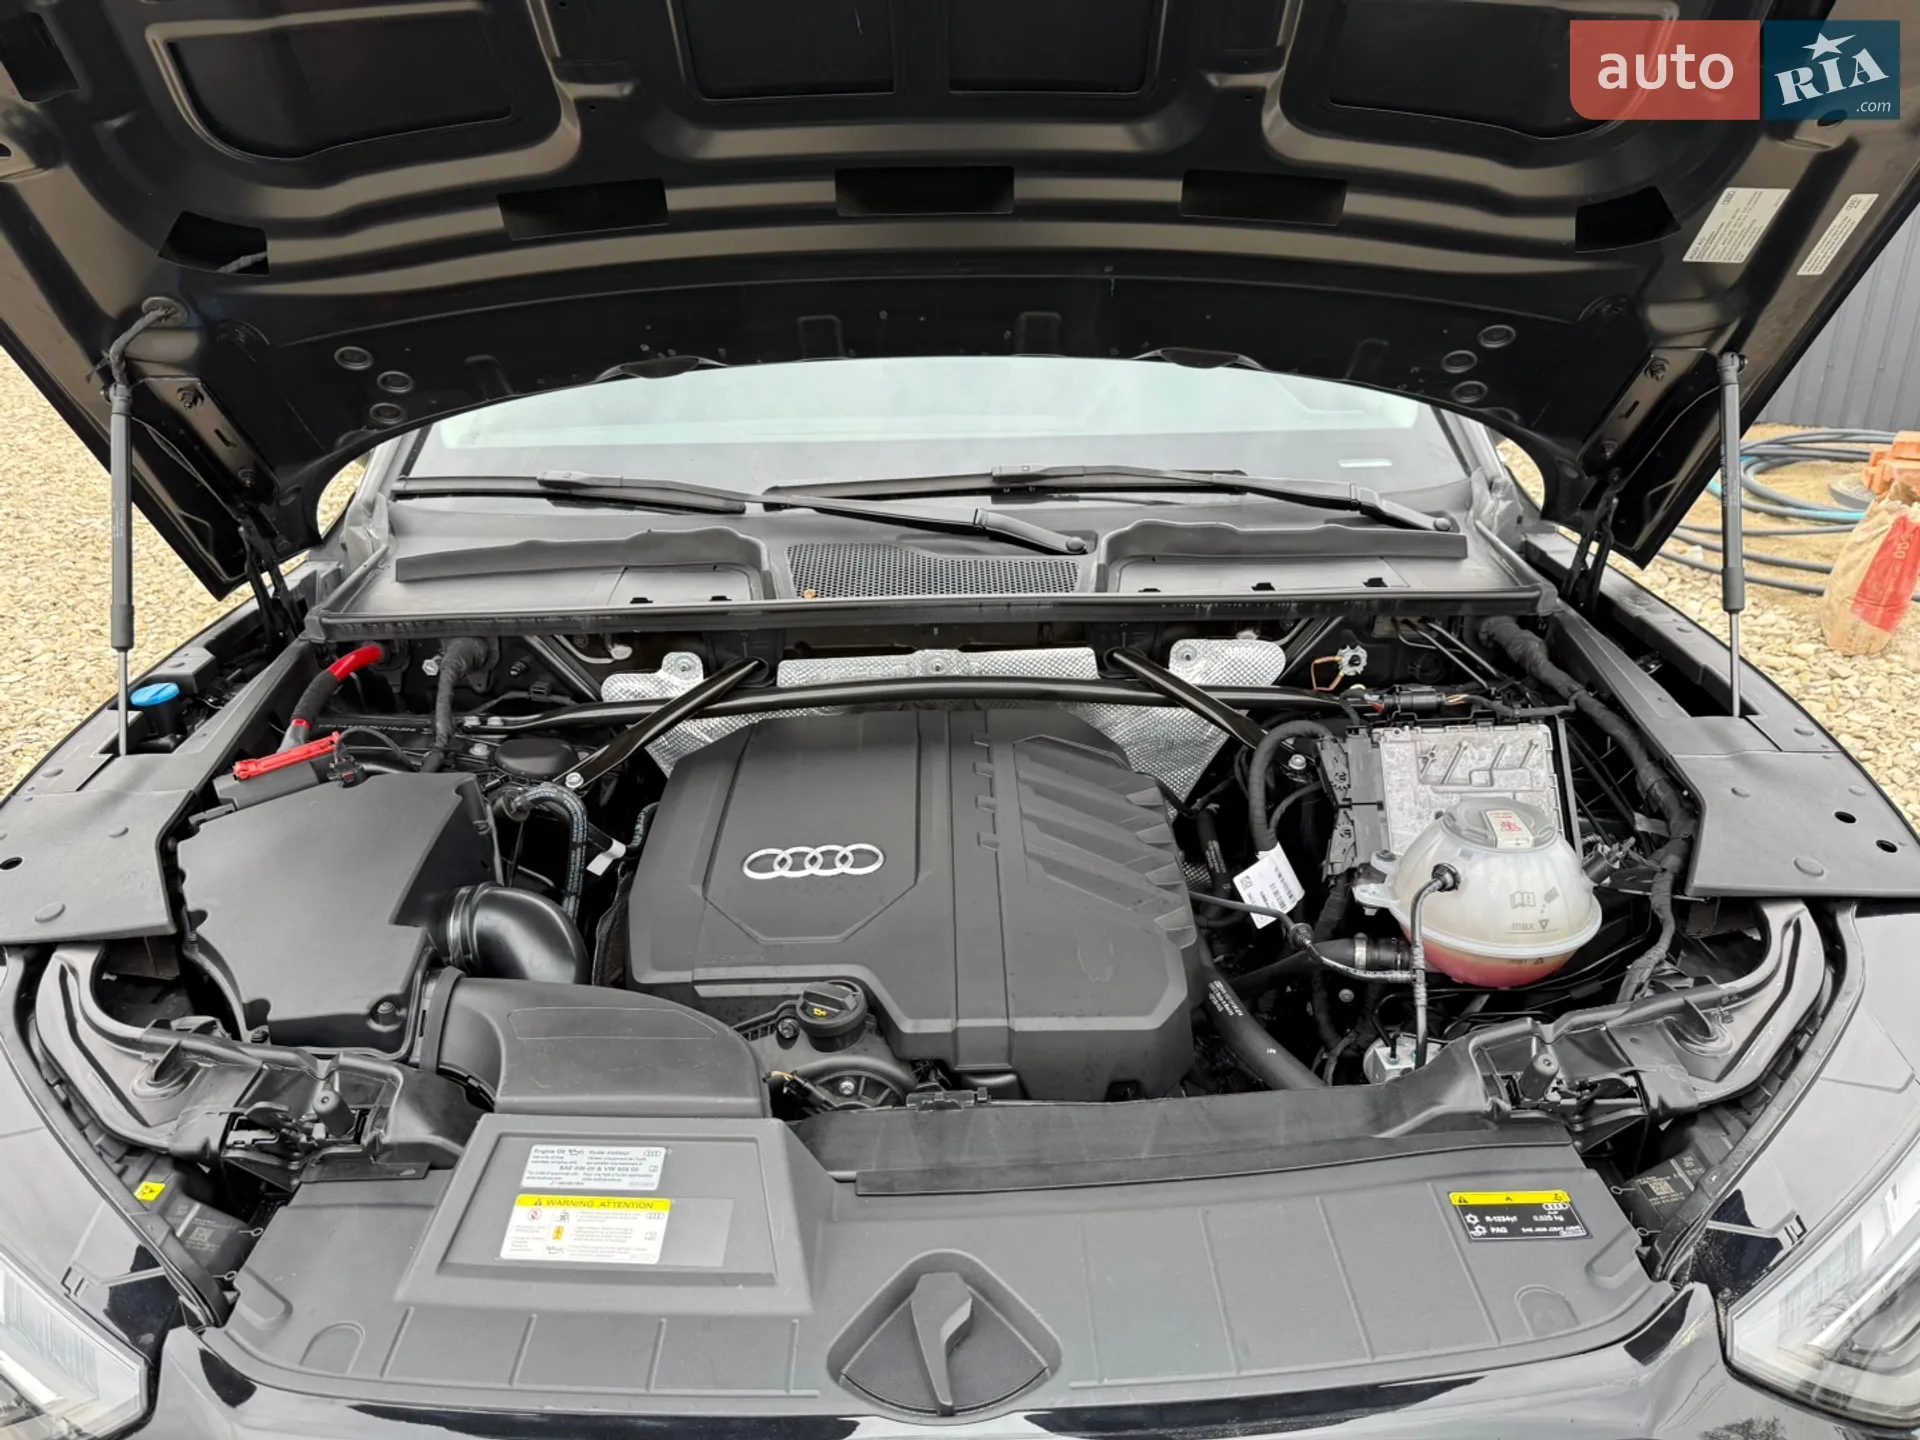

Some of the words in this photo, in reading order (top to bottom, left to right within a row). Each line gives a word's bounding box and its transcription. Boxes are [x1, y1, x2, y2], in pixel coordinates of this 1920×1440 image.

[1511, 922, 1535, 931] max
[546, 1200, 594, 1208] WARNING
[599, 1201, 654, 1209] ATTENTION
